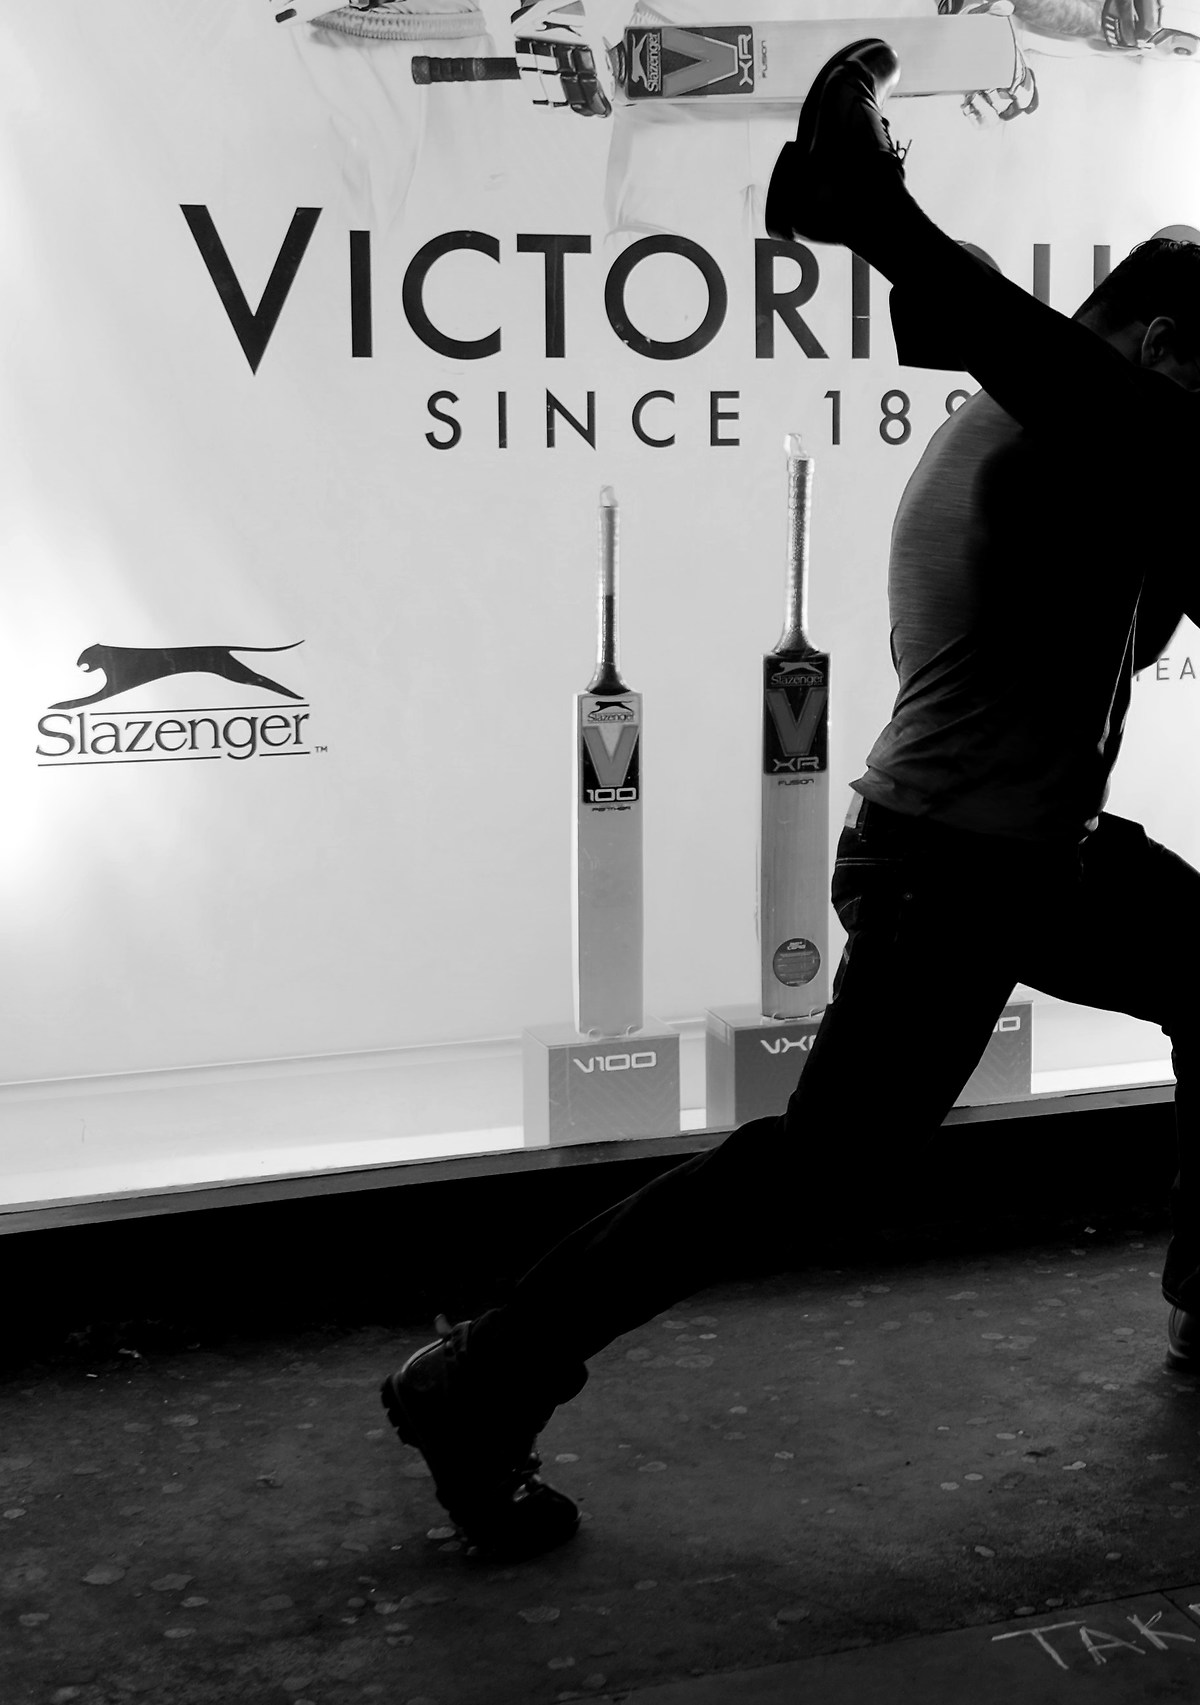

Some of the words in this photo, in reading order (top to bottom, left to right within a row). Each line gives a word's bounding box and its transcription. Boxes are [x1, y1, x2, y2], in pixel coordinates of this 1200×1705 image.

[647, 32, 661, 92] Slazenger
[738, 34, 753, 87] XR
[425, 388, 741, 450] SINCE
[35, 712, 310, 760] Slazenger
[766, 688, 828, 757] V
[583, 725, 640, 788] V
[772, 756, 820, 772] XR
[586, 787, 637, 802] 100
[573, 1051, 657, 1074] V100
